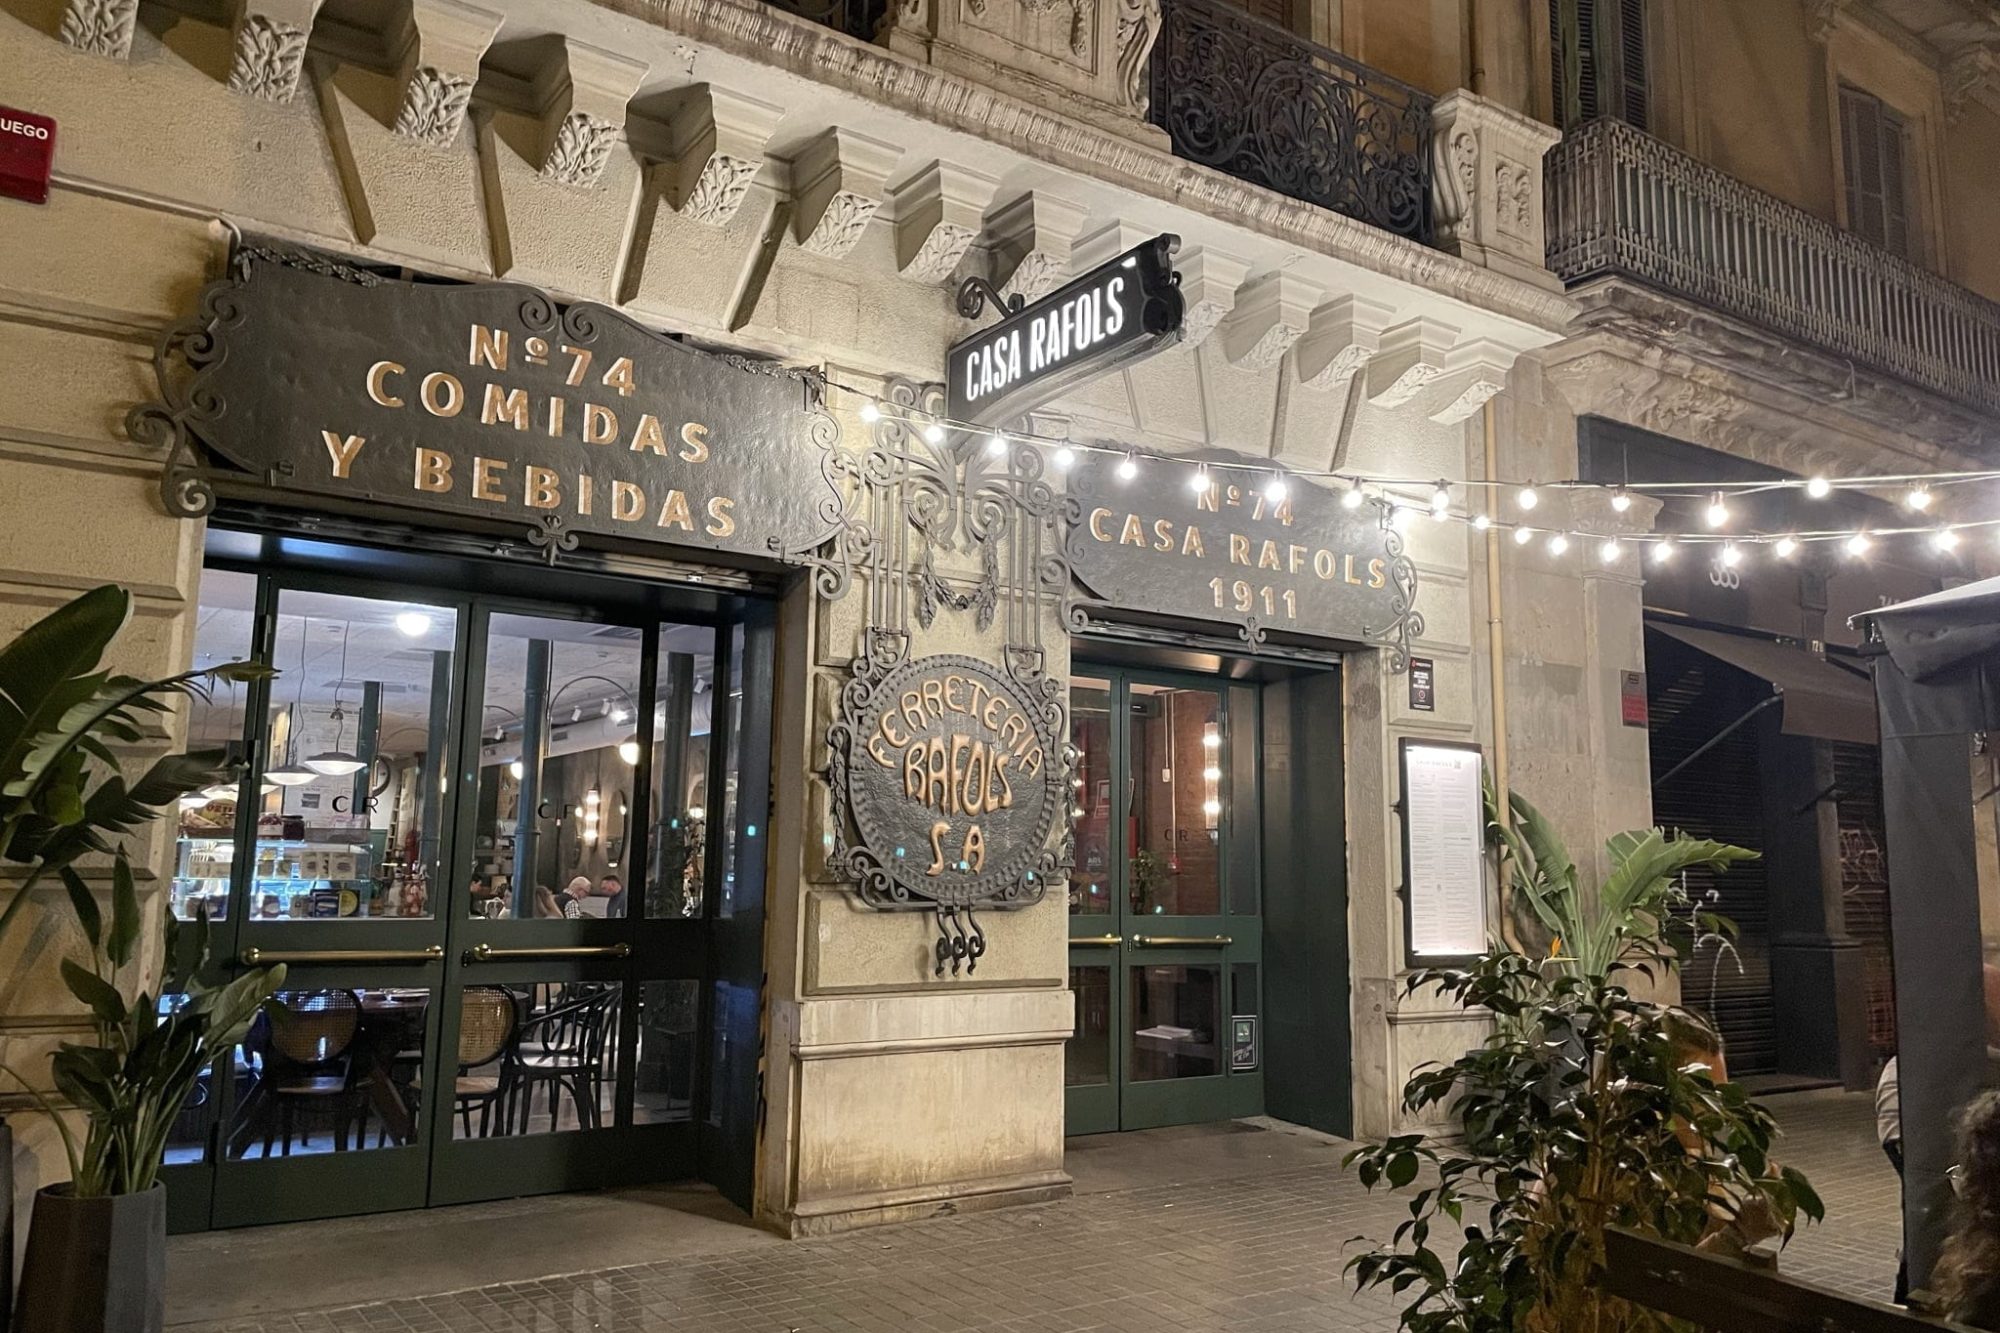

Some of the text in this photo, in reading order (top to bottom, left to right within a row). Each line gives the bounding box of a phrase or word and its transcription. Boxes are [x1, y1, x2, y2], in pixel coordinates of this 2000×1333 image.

[560, 345, 637, 397] 74
[965, 276, 1125, 402] CASA RAFOLS
[366, 361, 709, 463] COMIDAS
[321, 430, 737, 537] Y BEBIDAS
[1248, 487, 1294, 527] 74
[1089, 507, 1387, 589] CASA RAFOLS
[1208, 577, 1298, 619] 1911
[868, 675, 1043, 780] FERRETERIA
[904, 733, 1013, 817] RAFOLS
